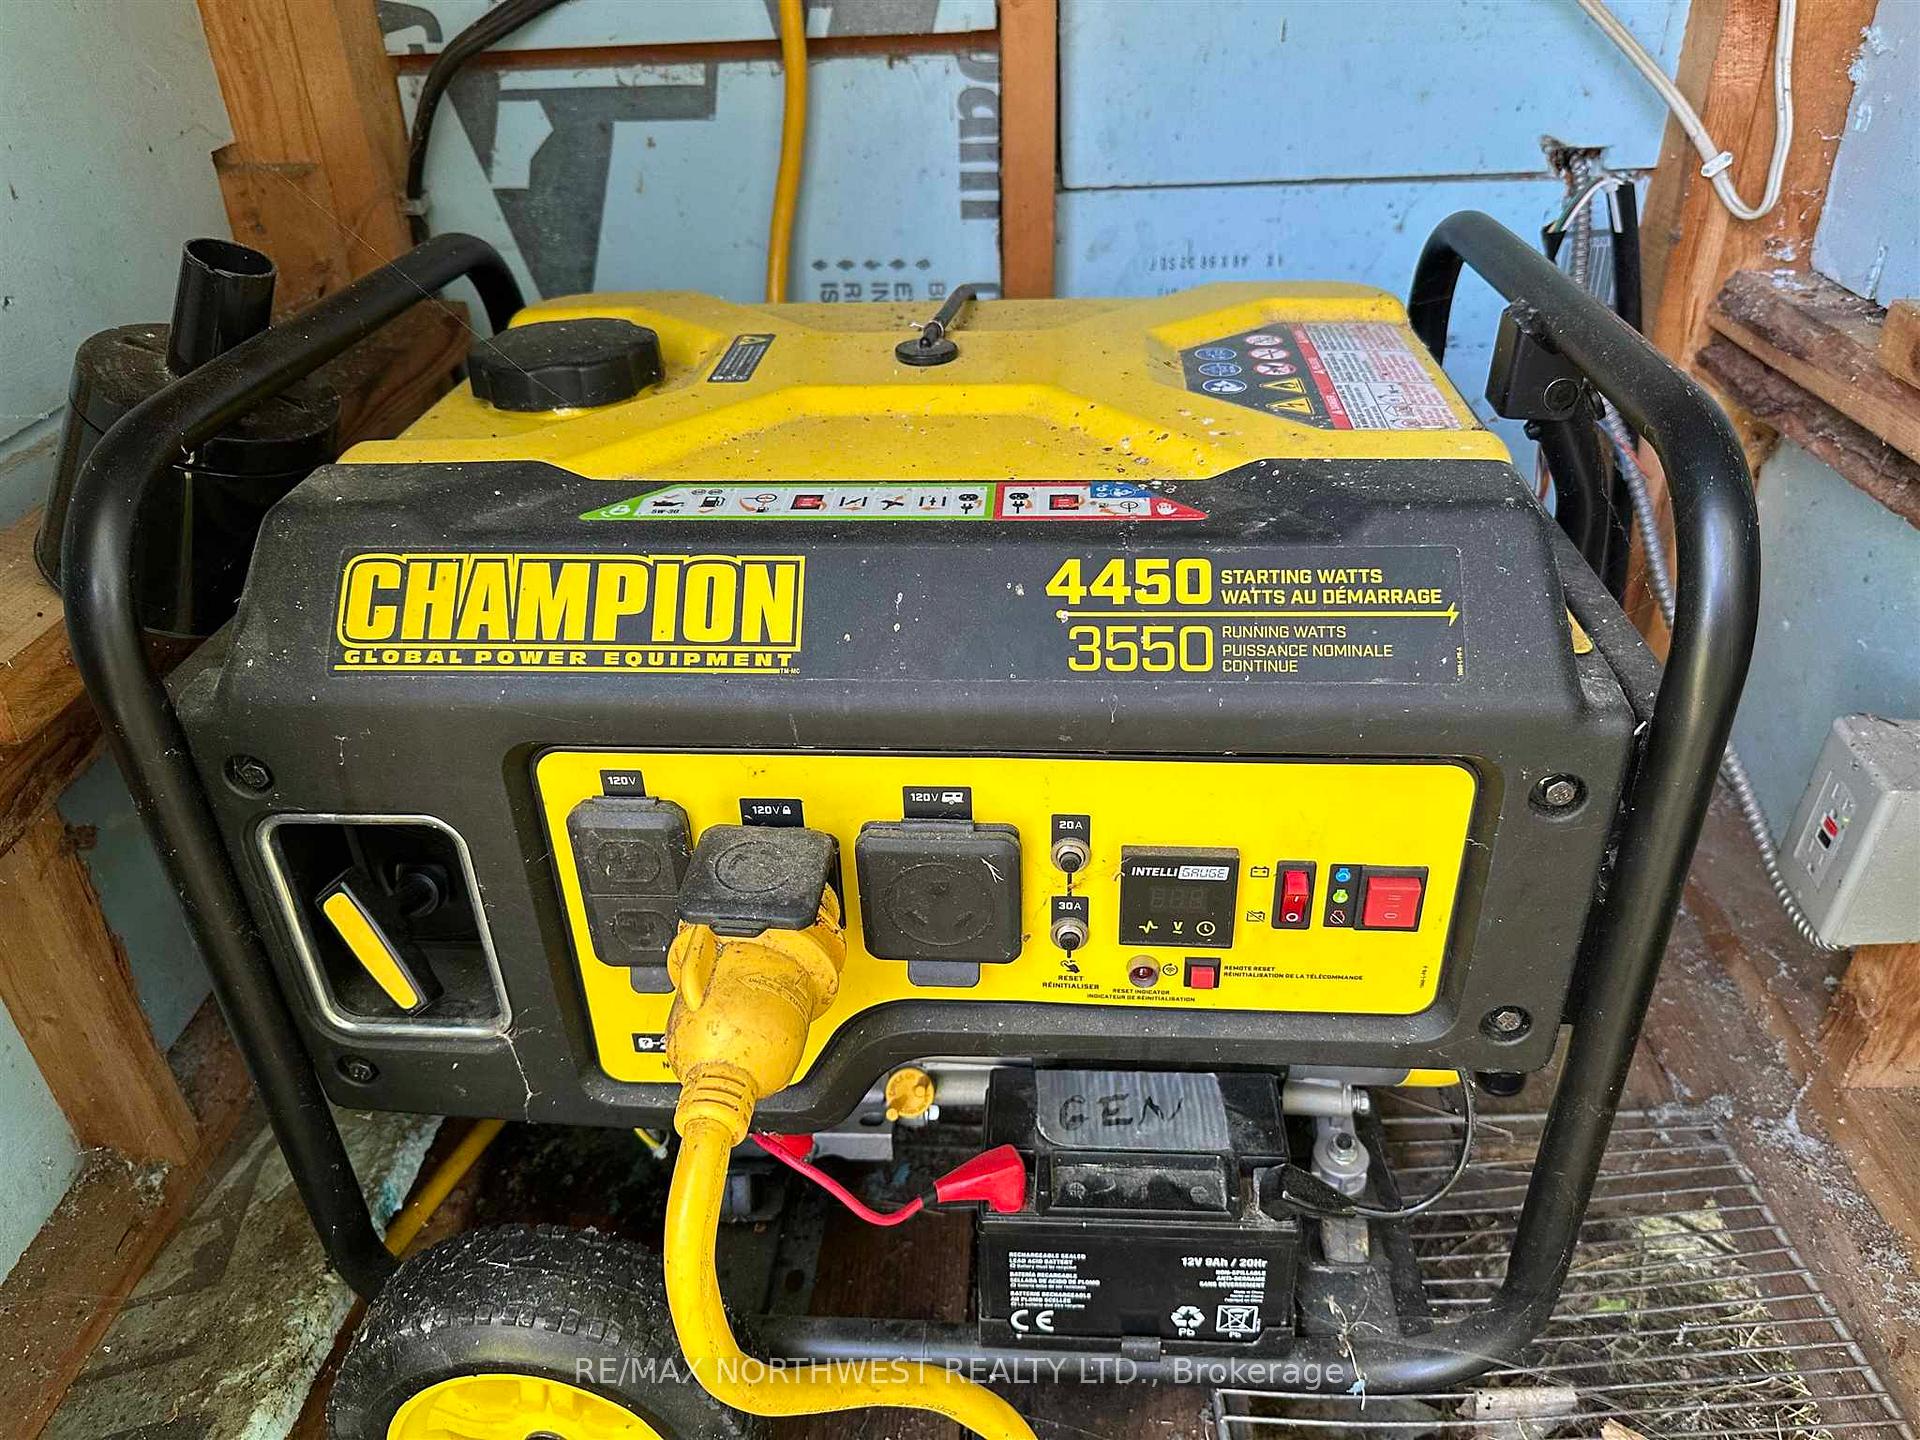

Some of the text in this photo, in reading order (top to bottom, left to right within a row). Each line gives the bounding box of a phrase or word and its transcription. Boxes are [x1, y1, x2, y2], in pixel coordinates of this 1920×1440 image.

[1045, 558, 1383, 605] 4450 STARTING WATTS
[1220, 585, 1442, 605] WATTS AU DÉMARRAGE
[345, 561, 793, 643] CHAMPION
[1067, 625, 1347, 672] 3550 RUNNING WATTS
[1221, 643, 1394, 658] PUISSANCE NOMINALE
[343, 650, 794, 668] GLOBAL POWER EQUIPMENT
[1221, 659, 1299, 673] CONTINUE
[607, 775, 637, 786] 120V
[910, 792, 939, 803] 120V
[751, 804, 780, 816] 120V
[1058, 820, 1083, 830] 20A
[1058, 901, 1083, 911] 30A
[1223, 970, 1284, 978] RÉINITIALISATION
[1305, 973, 1364, 981] TÉLÉCOMMANDE
[1042, 981, 1100, 990] RÉINITIALISER
[1137, 995, 1196, 1003] RÉINITIALISATION
[1059, 1093, 1184, 1131] GEN
[1181, 1257, 1203, 1268] 12V
[1230, 1257, 1238, 1268] /
[1041, 1291, 1092, 1299] RECHARGEABLE
[1010, 1309, 1054, 1332] CE
[1178, 1327, 1197, 1338] Pb
[1228, 1332, 1242, 1340] Pb
